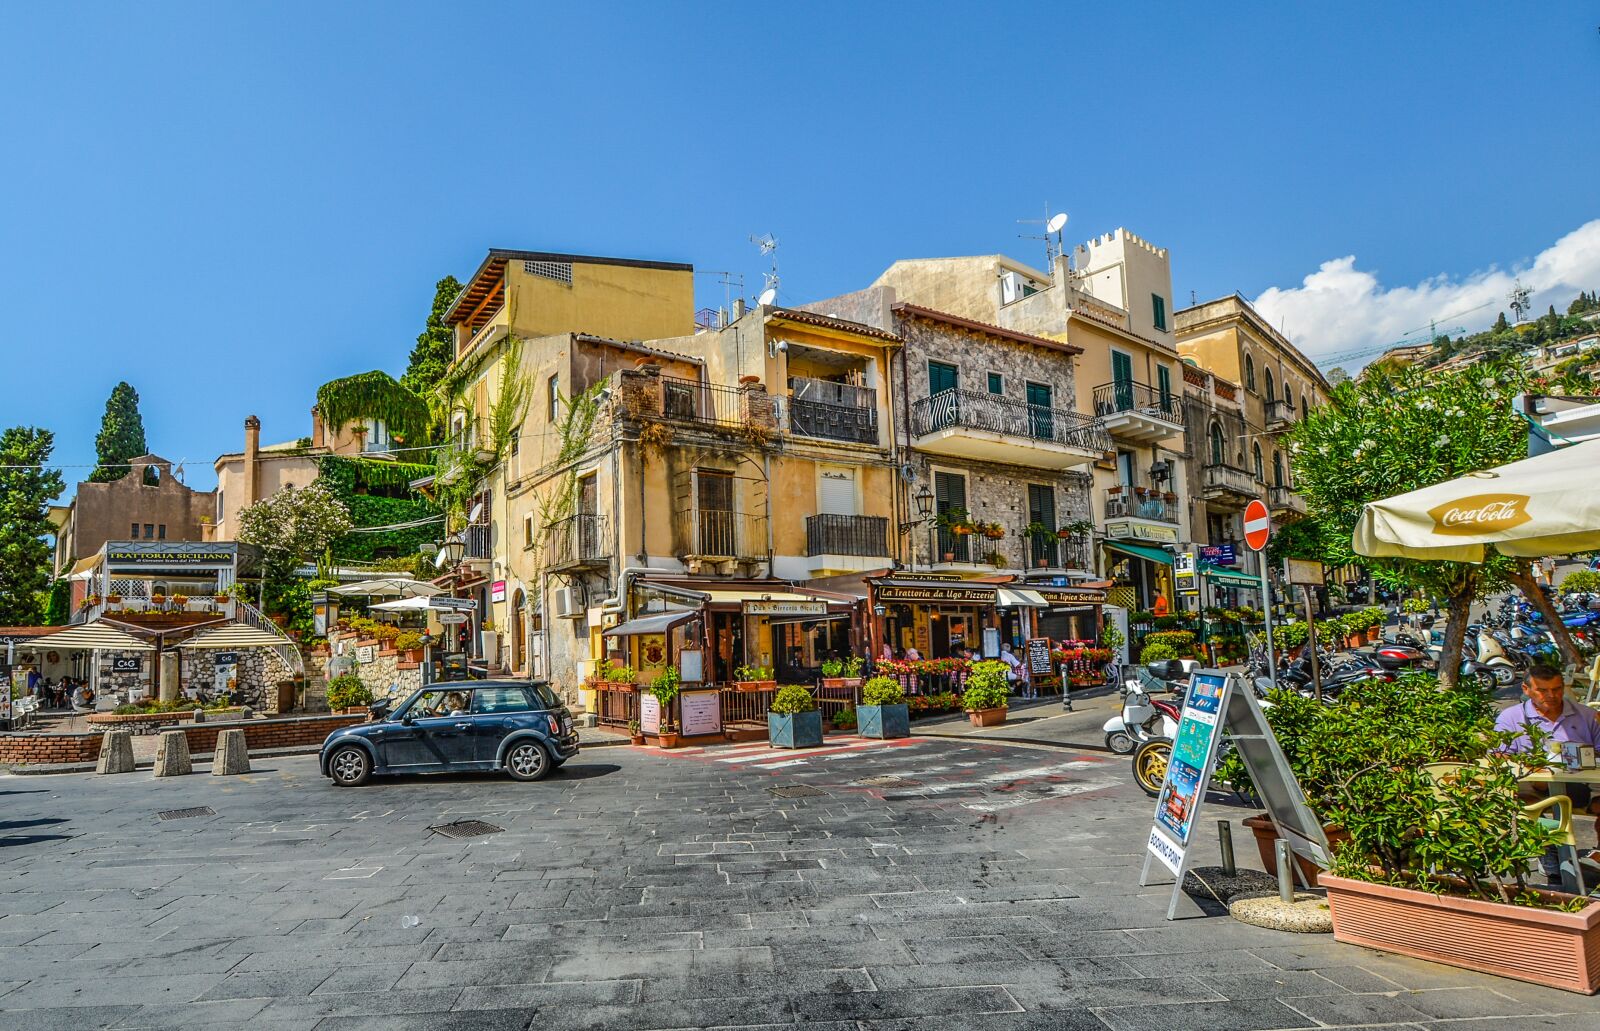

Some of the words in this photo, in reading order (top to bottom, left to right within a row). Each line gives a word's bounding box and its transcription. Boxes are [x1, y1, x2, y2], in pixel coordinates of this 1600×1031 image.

[1442, 500, 1519, 526] Coca-Cola
[882, 588, 892, 596] La
[894, 588, 930, 598] Trattoria
[933, 590, 944, 598] da
[946, 590, 962, 600] Ugo
[964, 590, 994, 599] Pizzeria
[1060, 592, 1078, 602] Tipica
[1080, 594, 1104, 602] Siciliana
[117, 660, 136, 668] C&G
[1150, 833, 1169, 857] BOOKING
[1168, 848, 1181, 869] POINT
